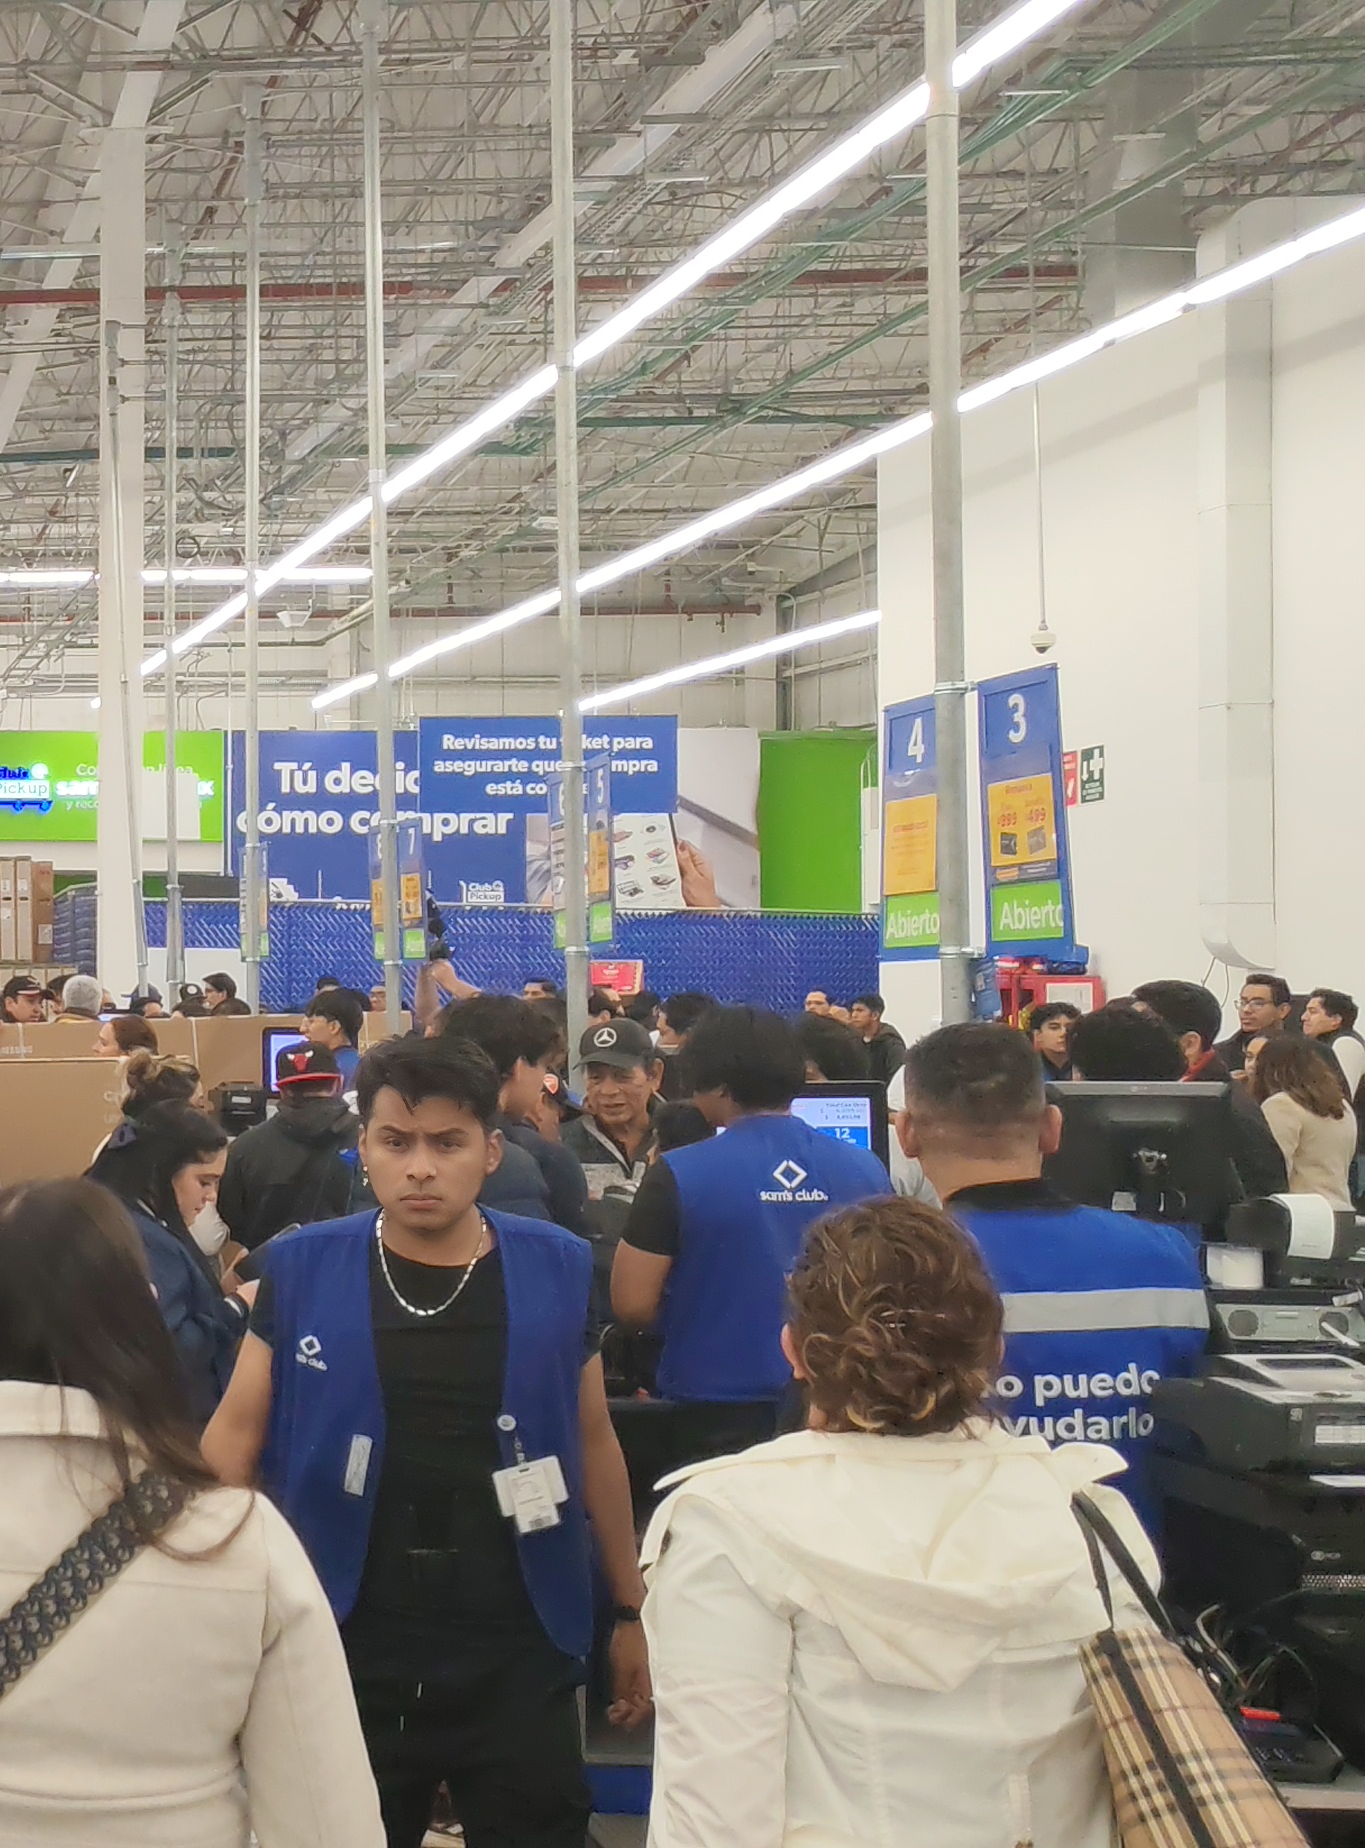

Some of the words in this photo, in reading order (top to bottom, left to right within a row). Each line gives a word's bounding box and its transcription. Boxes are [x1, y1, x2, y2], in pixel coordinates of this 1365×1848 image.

[1008, 694, 1027, 743] 3
[442, 734, 536, 750] Revisamos
[538, 736, 557, 750] tu
[613, 736, 653, 752] para
[907, 718, 925, 763] 4
[273, 762, 317, 794] Tú
[433, 758, 528, 775] asegurarte
[485, 779, 523, 795] está
[596, 768, 605, 803] 5
[885, 908, 940, 940] Abierto
[835, 1127, 851, 1139] 12
[759, 1189, 793, 1202] sam's
[1001, 1407, 1155, 1441] yudarlo
